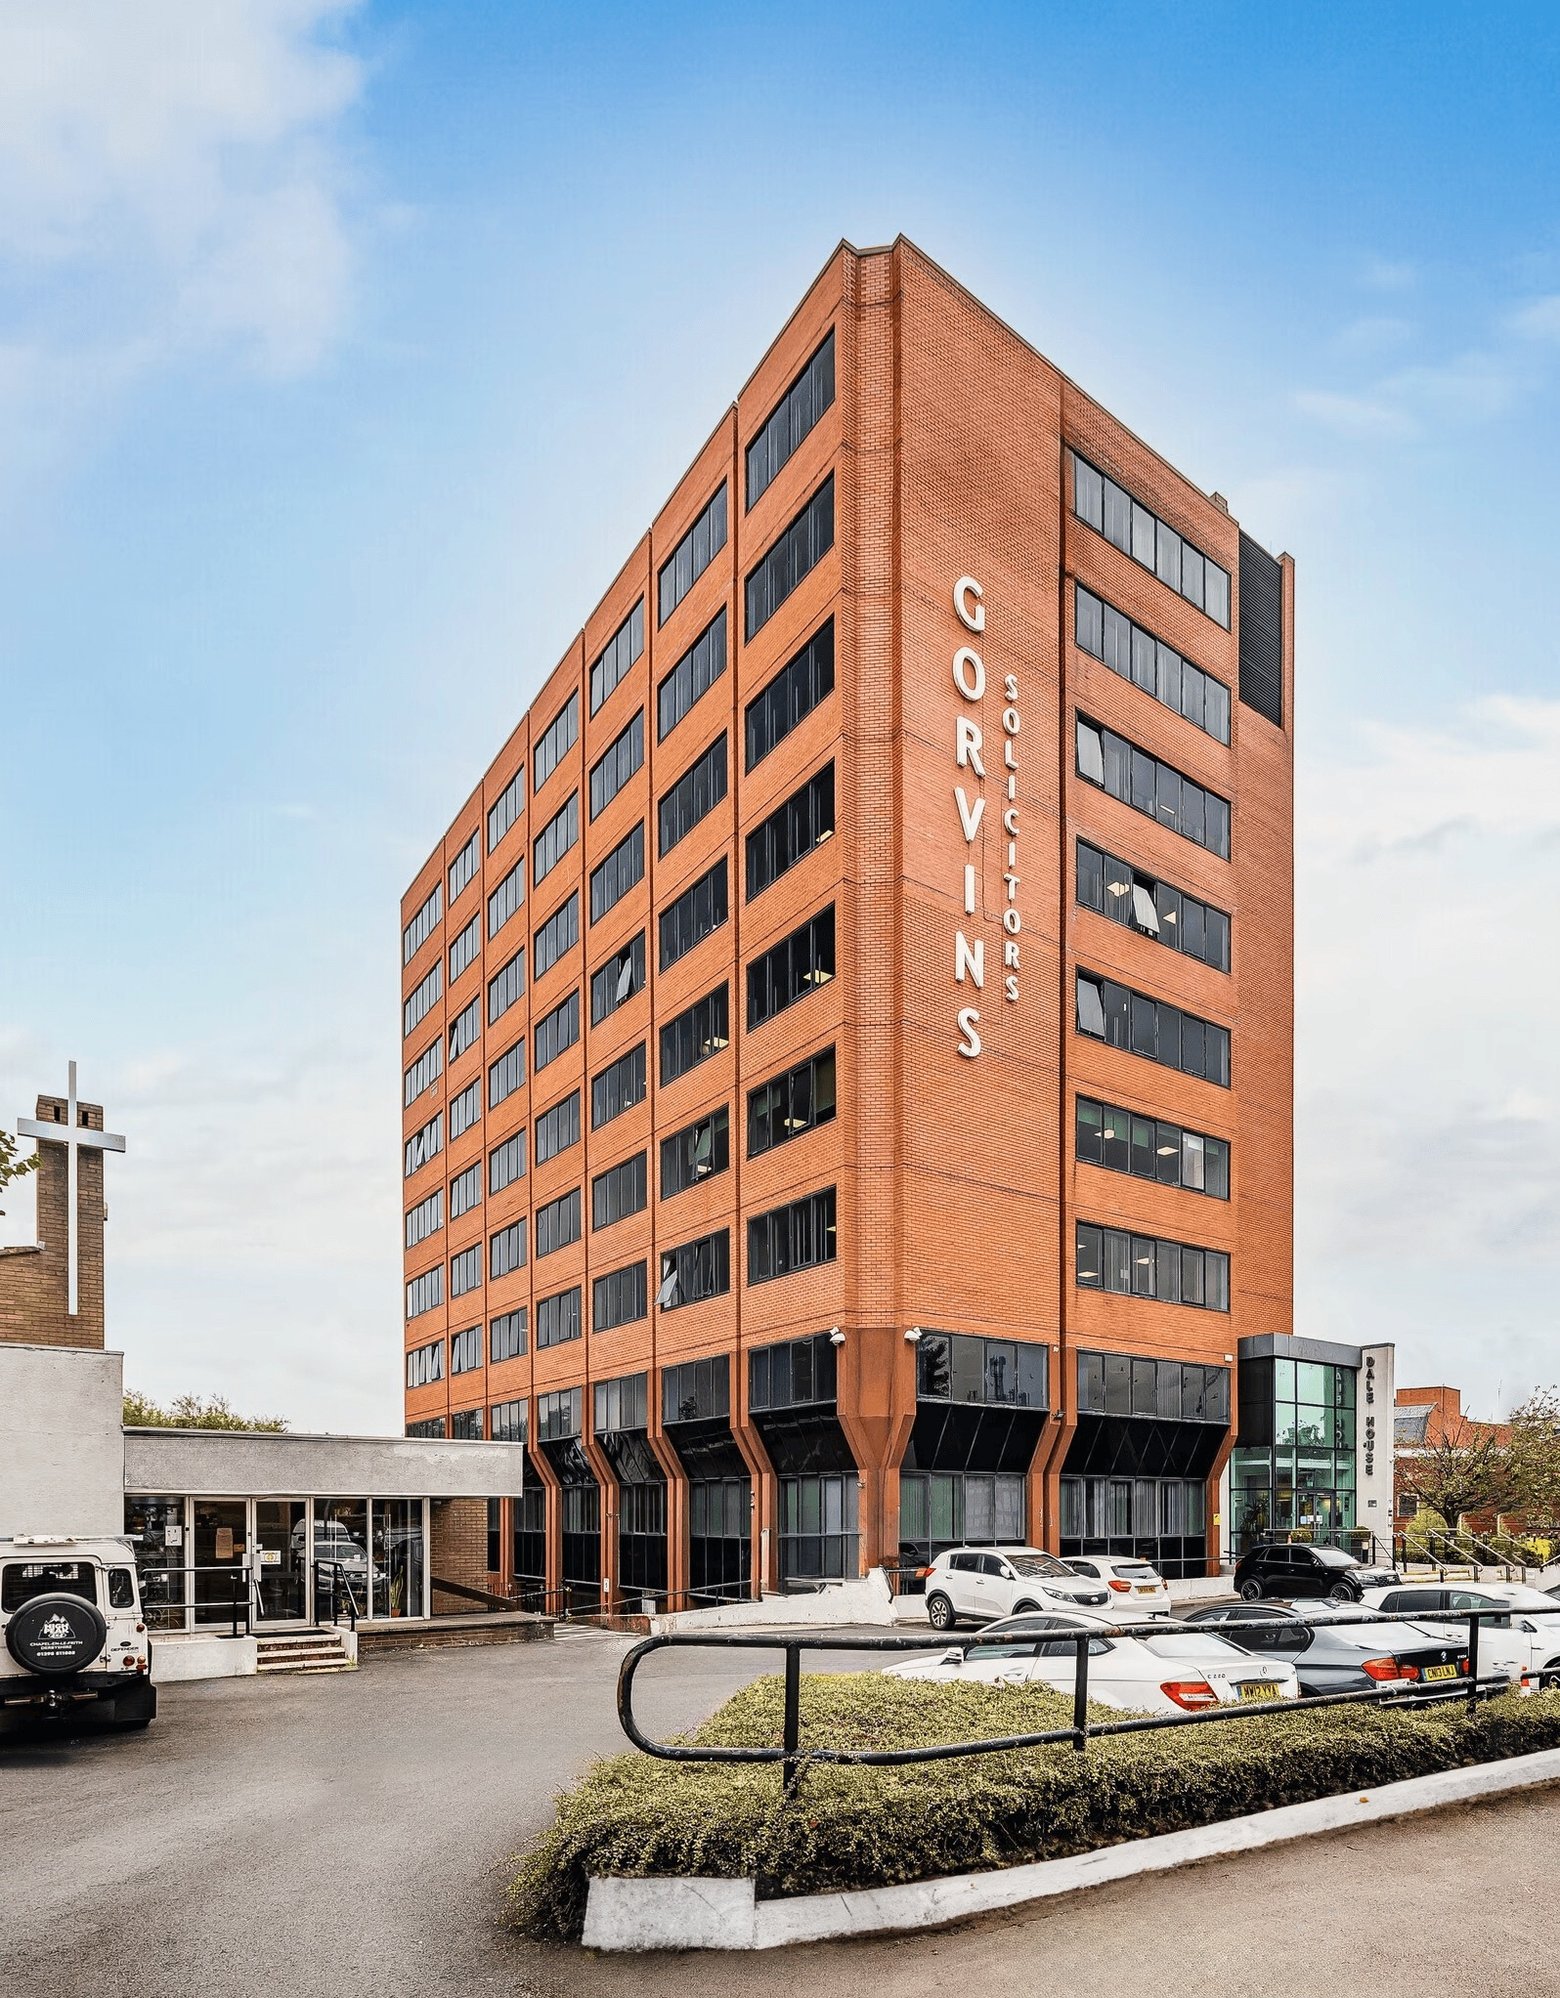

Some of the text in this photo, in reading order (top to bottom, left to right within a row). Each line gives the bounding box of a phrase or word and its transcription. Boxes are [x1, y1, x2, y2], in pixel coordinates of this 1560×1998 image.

[952, 575, 986, 1058] GORVINS
[1002, 673, 1021, 1002] SOLICITORS
[1365, 1356, 1376, 1476] DALE HOUSE
